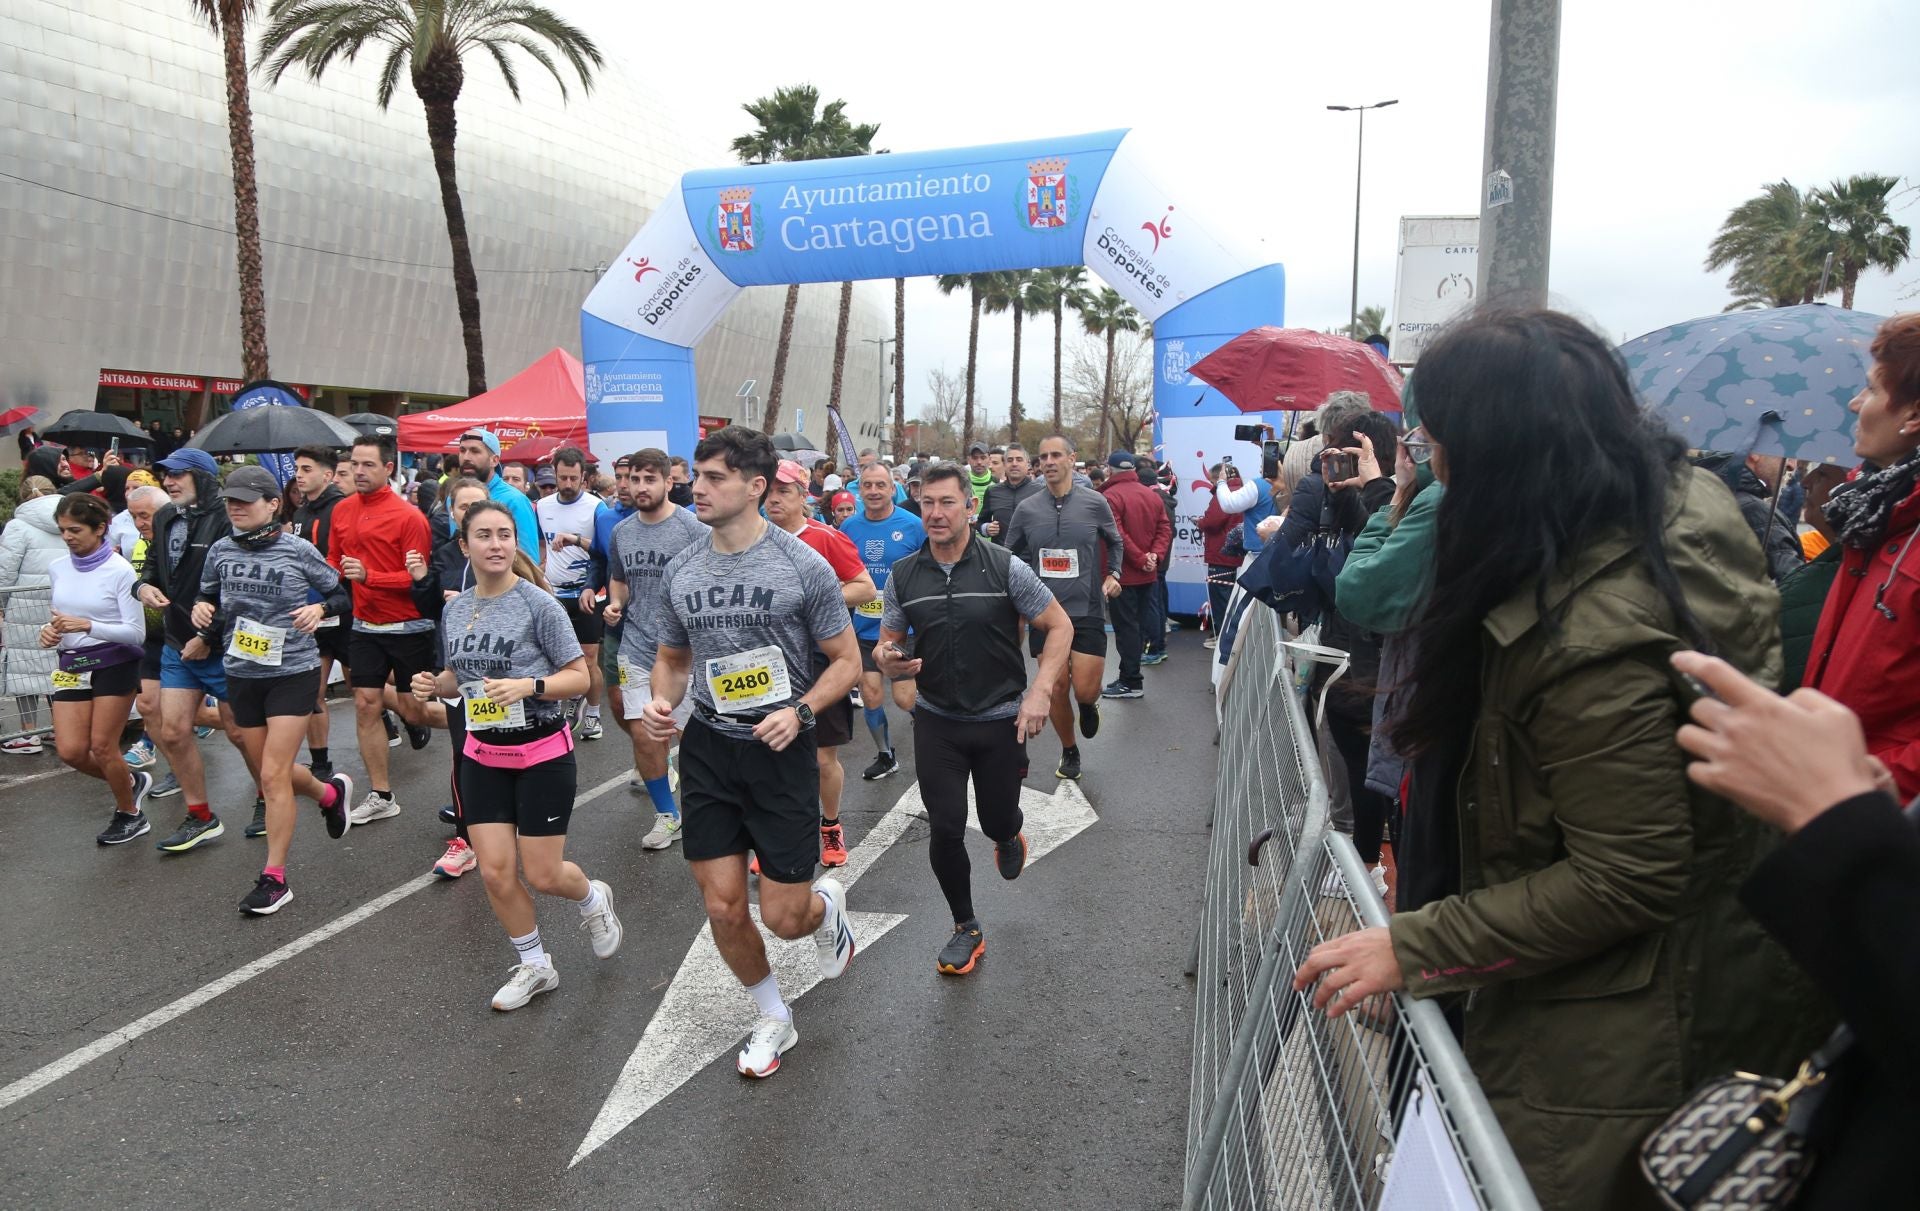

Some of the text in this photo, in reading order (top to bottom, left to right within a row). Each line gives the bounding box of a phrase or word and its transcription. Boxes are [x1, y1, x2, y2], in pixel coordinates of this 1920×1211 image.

[779, 173, 991, 214] Ayuntamiento
[780, 209, 994, 253] Cartagena
[1097, 234, 1164, 299] Deportes
[1104, 227, 1156, 276] Concejalía
[1156, 274, 1171, 289] de
[637, 257, 691, 317] Concejalía de
[644, 264, 701, 326] Deportes
[98, 372, 199, 389] ENTRADA GENERAL
[603, 371, 662, 382] Ayuntamiento
[603, 381, 663, 394] Cartagena
[625, 550, 673, 568] UCAM
[220, 563, 285, 585] UCAM
[685, 584, 774, 614] UCAM
[687, 613, 772, 630] UNIVERSIDAD
[238, 634, 269, 652] 2313
[449, 633, 515, 659] UCAM
[721, 671, 770, 693] 2480
